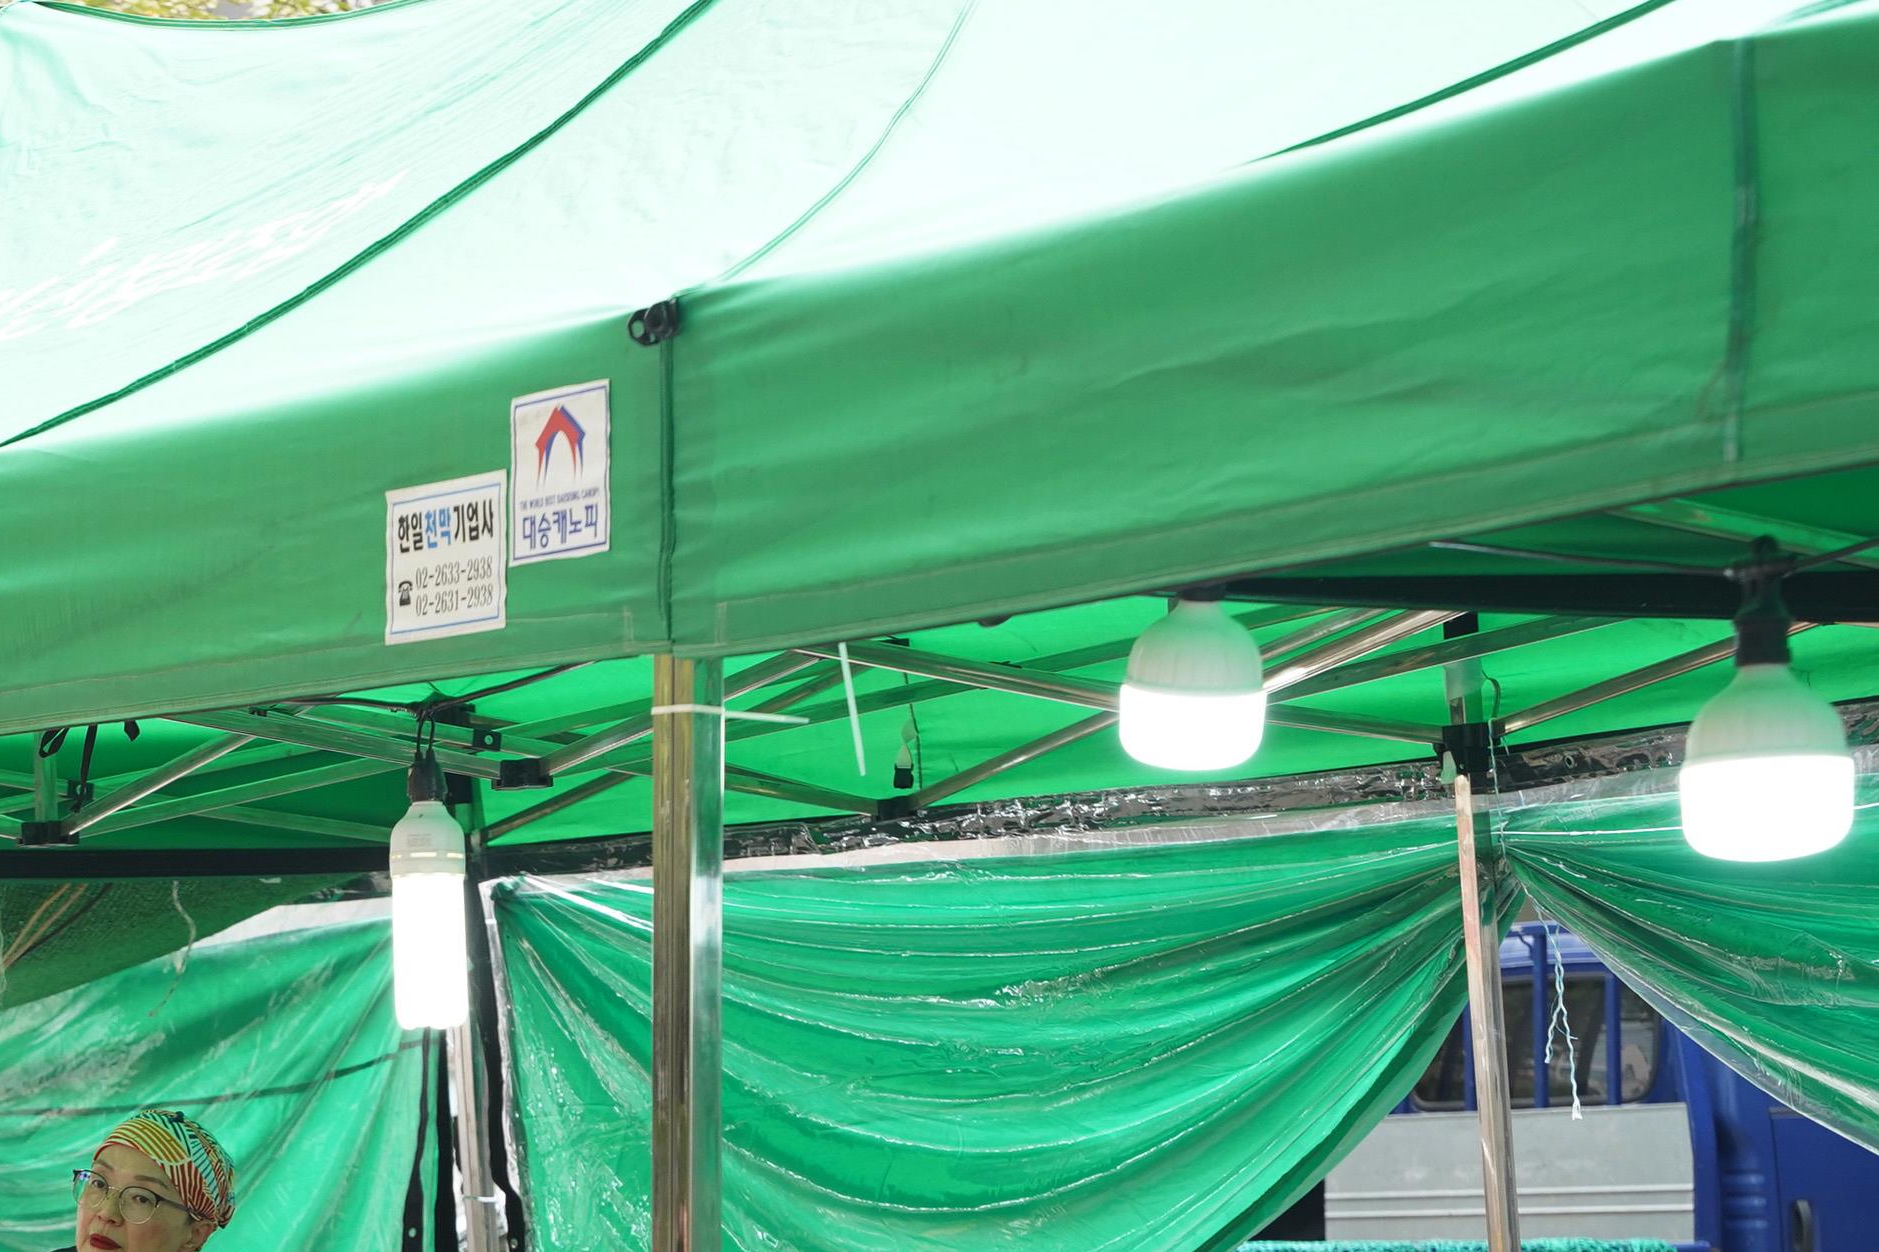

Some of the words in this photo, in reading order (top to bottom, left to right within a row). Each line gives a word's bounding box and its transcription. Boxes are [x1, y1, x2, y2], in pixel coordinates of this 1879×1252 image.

[397, 498, 494, 554] 한일천막기업사
[522, 502, 598, 550] 대승캐노피
[415, 555, 493, 590] 02-2633-2938
[415, 583, 494, 617] 02-2631-2938
